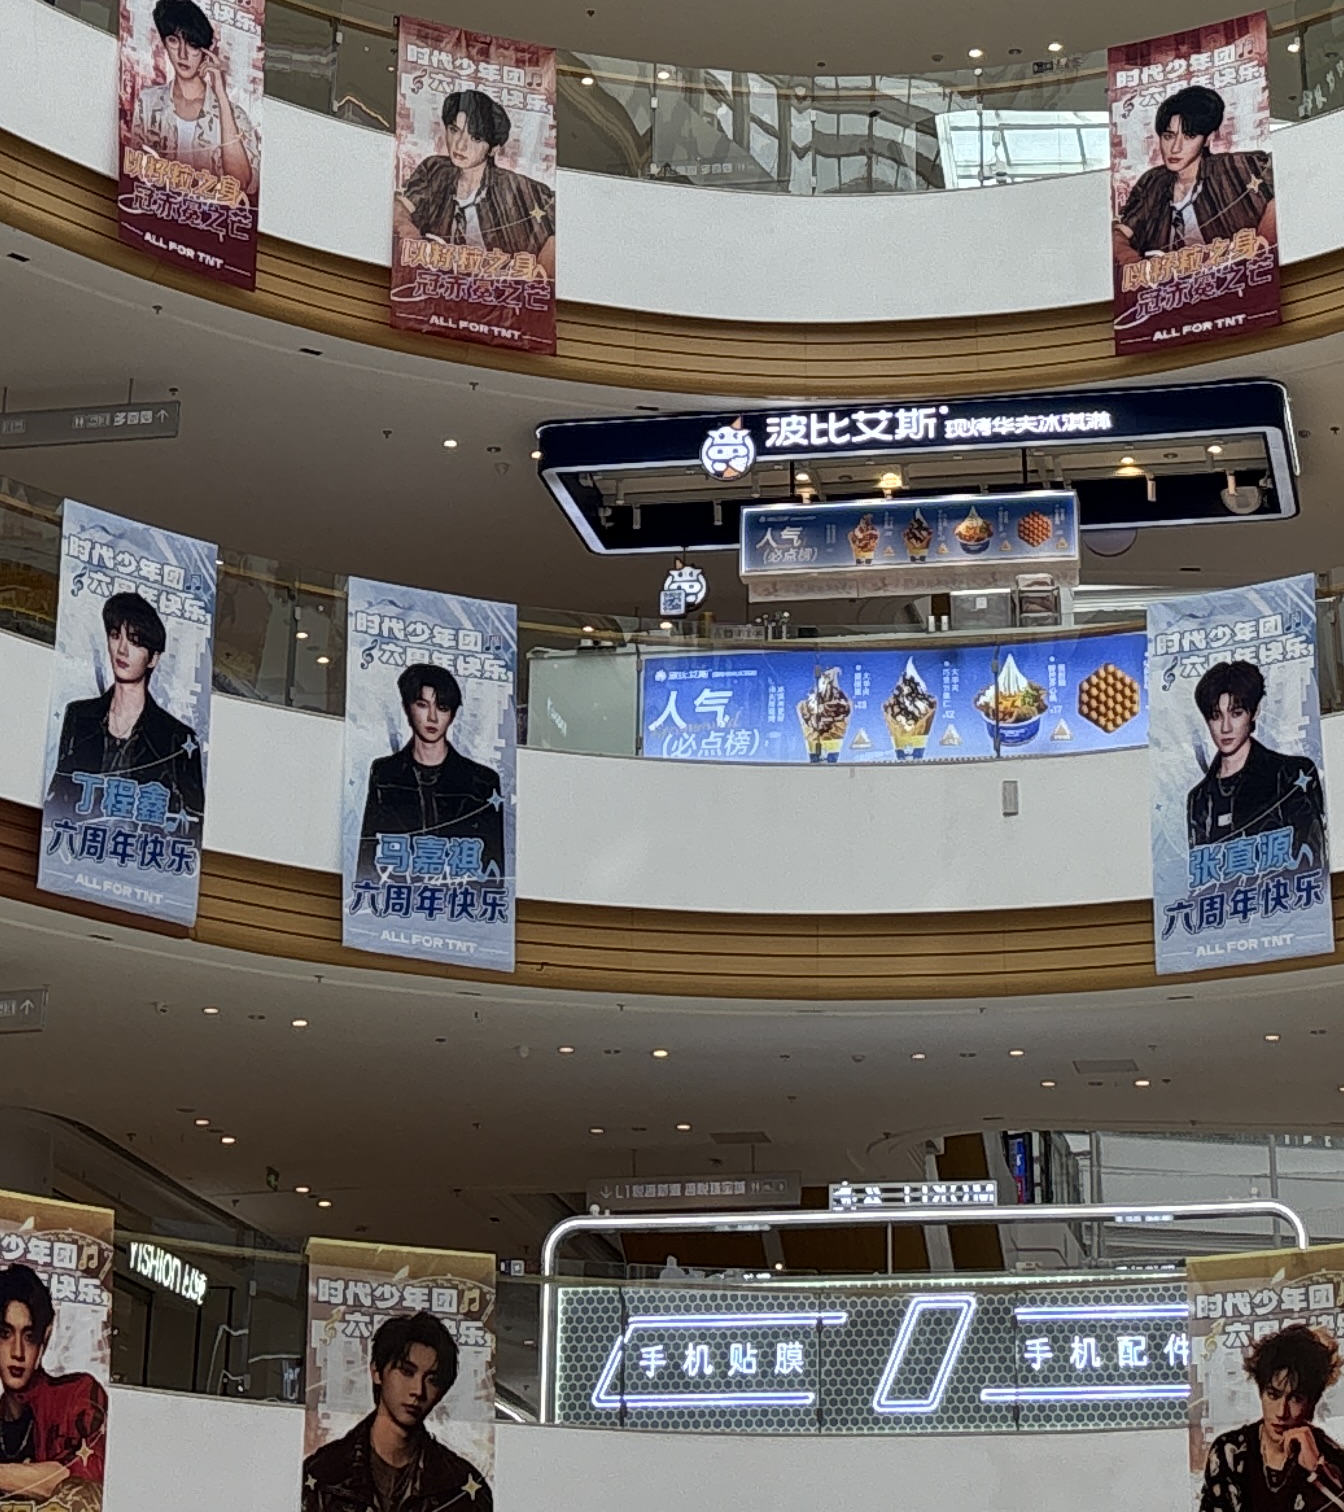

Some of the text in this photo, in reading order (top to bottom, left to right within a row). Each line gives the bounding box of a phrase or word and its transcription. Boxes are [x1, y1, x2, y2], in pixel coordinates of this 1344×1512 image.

[407, 46, 524, 84] 时代少年团
[1116, 47, 1235, 89] 时代少年团
[429, 316, 519, 338] ALL FOR TNT
[1153, 314, 1244, 340] ALL FOR TNT
[766, 407, 1112, 447] 波比艾斯 现烤华夫冰淇淋
[756, 526, 803, 549] 人气
[68, 537, 183, 590] 时代少年团
[357, 613, 482, 652] 时代少年团
[1157, 615, 1281, 655] 时代少年团
[649, 688, 733, 731] 人气
[71, 772, 169, 827] 丁程鑫
[48, 823, 194, 881] 六周年快乐
[377, 833, 482, 876] 马嘉祺
[1191, 829, 1295, 886] 张真源
[352, 882, 505, 924] 六周年快乐
[1164, 872, 1321, 937] 六周年快乐
[380, 929, 476, 953] ALL FOR TNT
[318, 1280, 456, 1313] 时代少年团
[1197, 1284, 1335, 1318] 时代少年团
[638, 1343, 805, 1379] 手机贴膜
[1023, 1332, 1190, 1370] 手机配件
